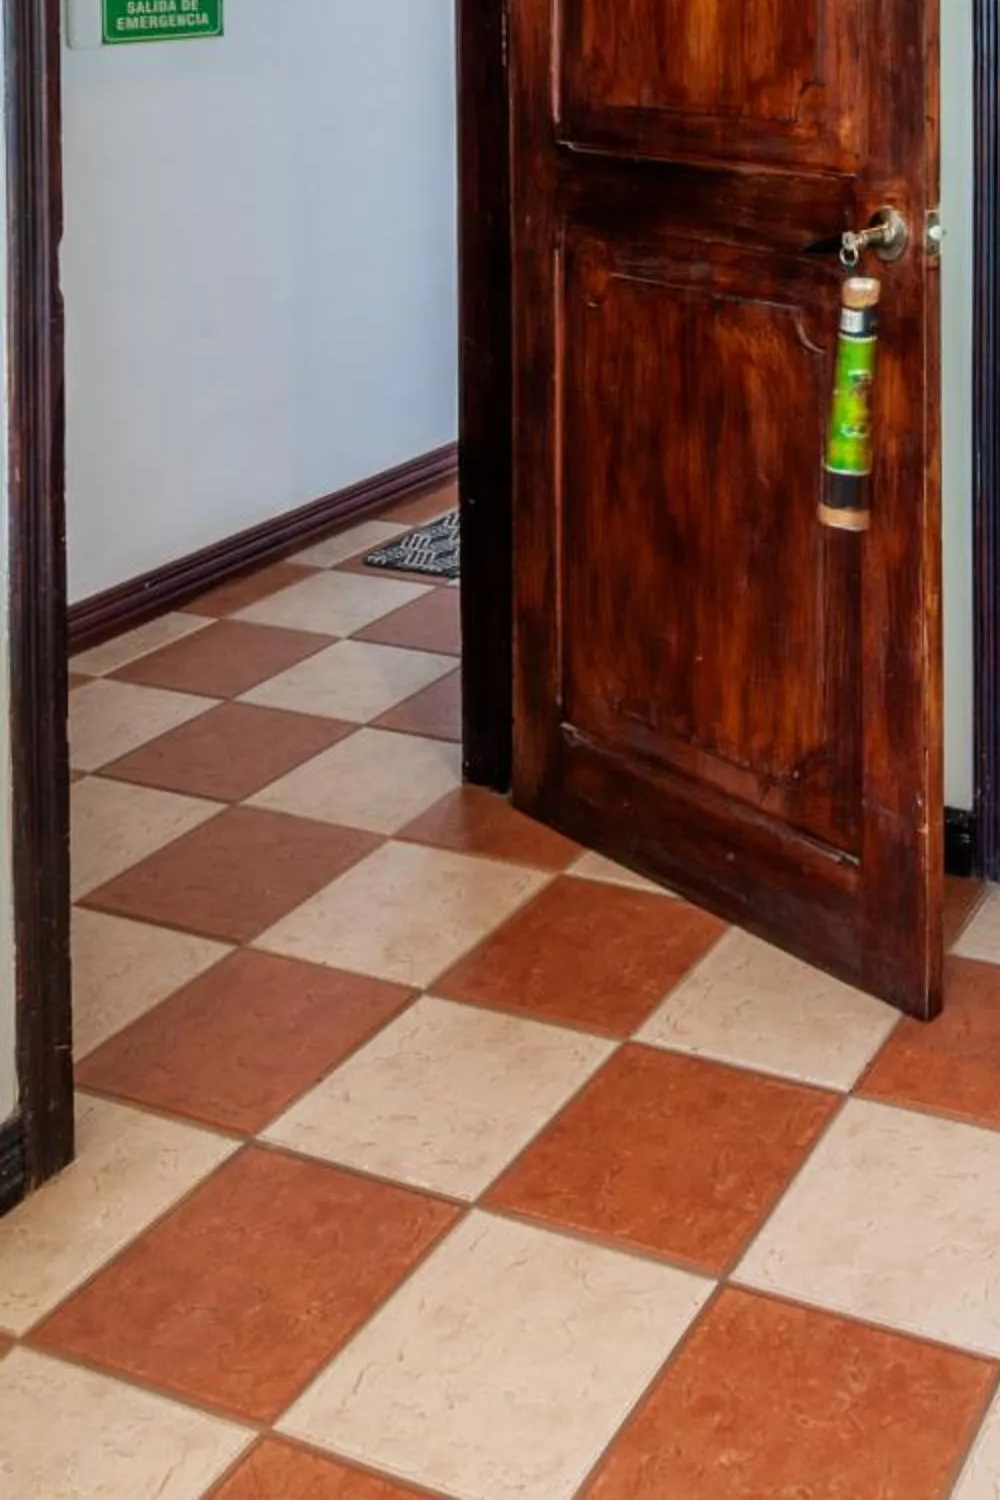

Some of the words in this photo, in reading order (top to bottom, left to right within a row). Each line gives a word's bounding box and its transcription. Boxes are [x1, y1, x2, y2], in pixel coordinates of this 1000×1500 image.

[127, 0, 177, 14] SALIDA
[181, 0, 199, 11] DE
[116, 12, 210, 31] EMERGENCIA
